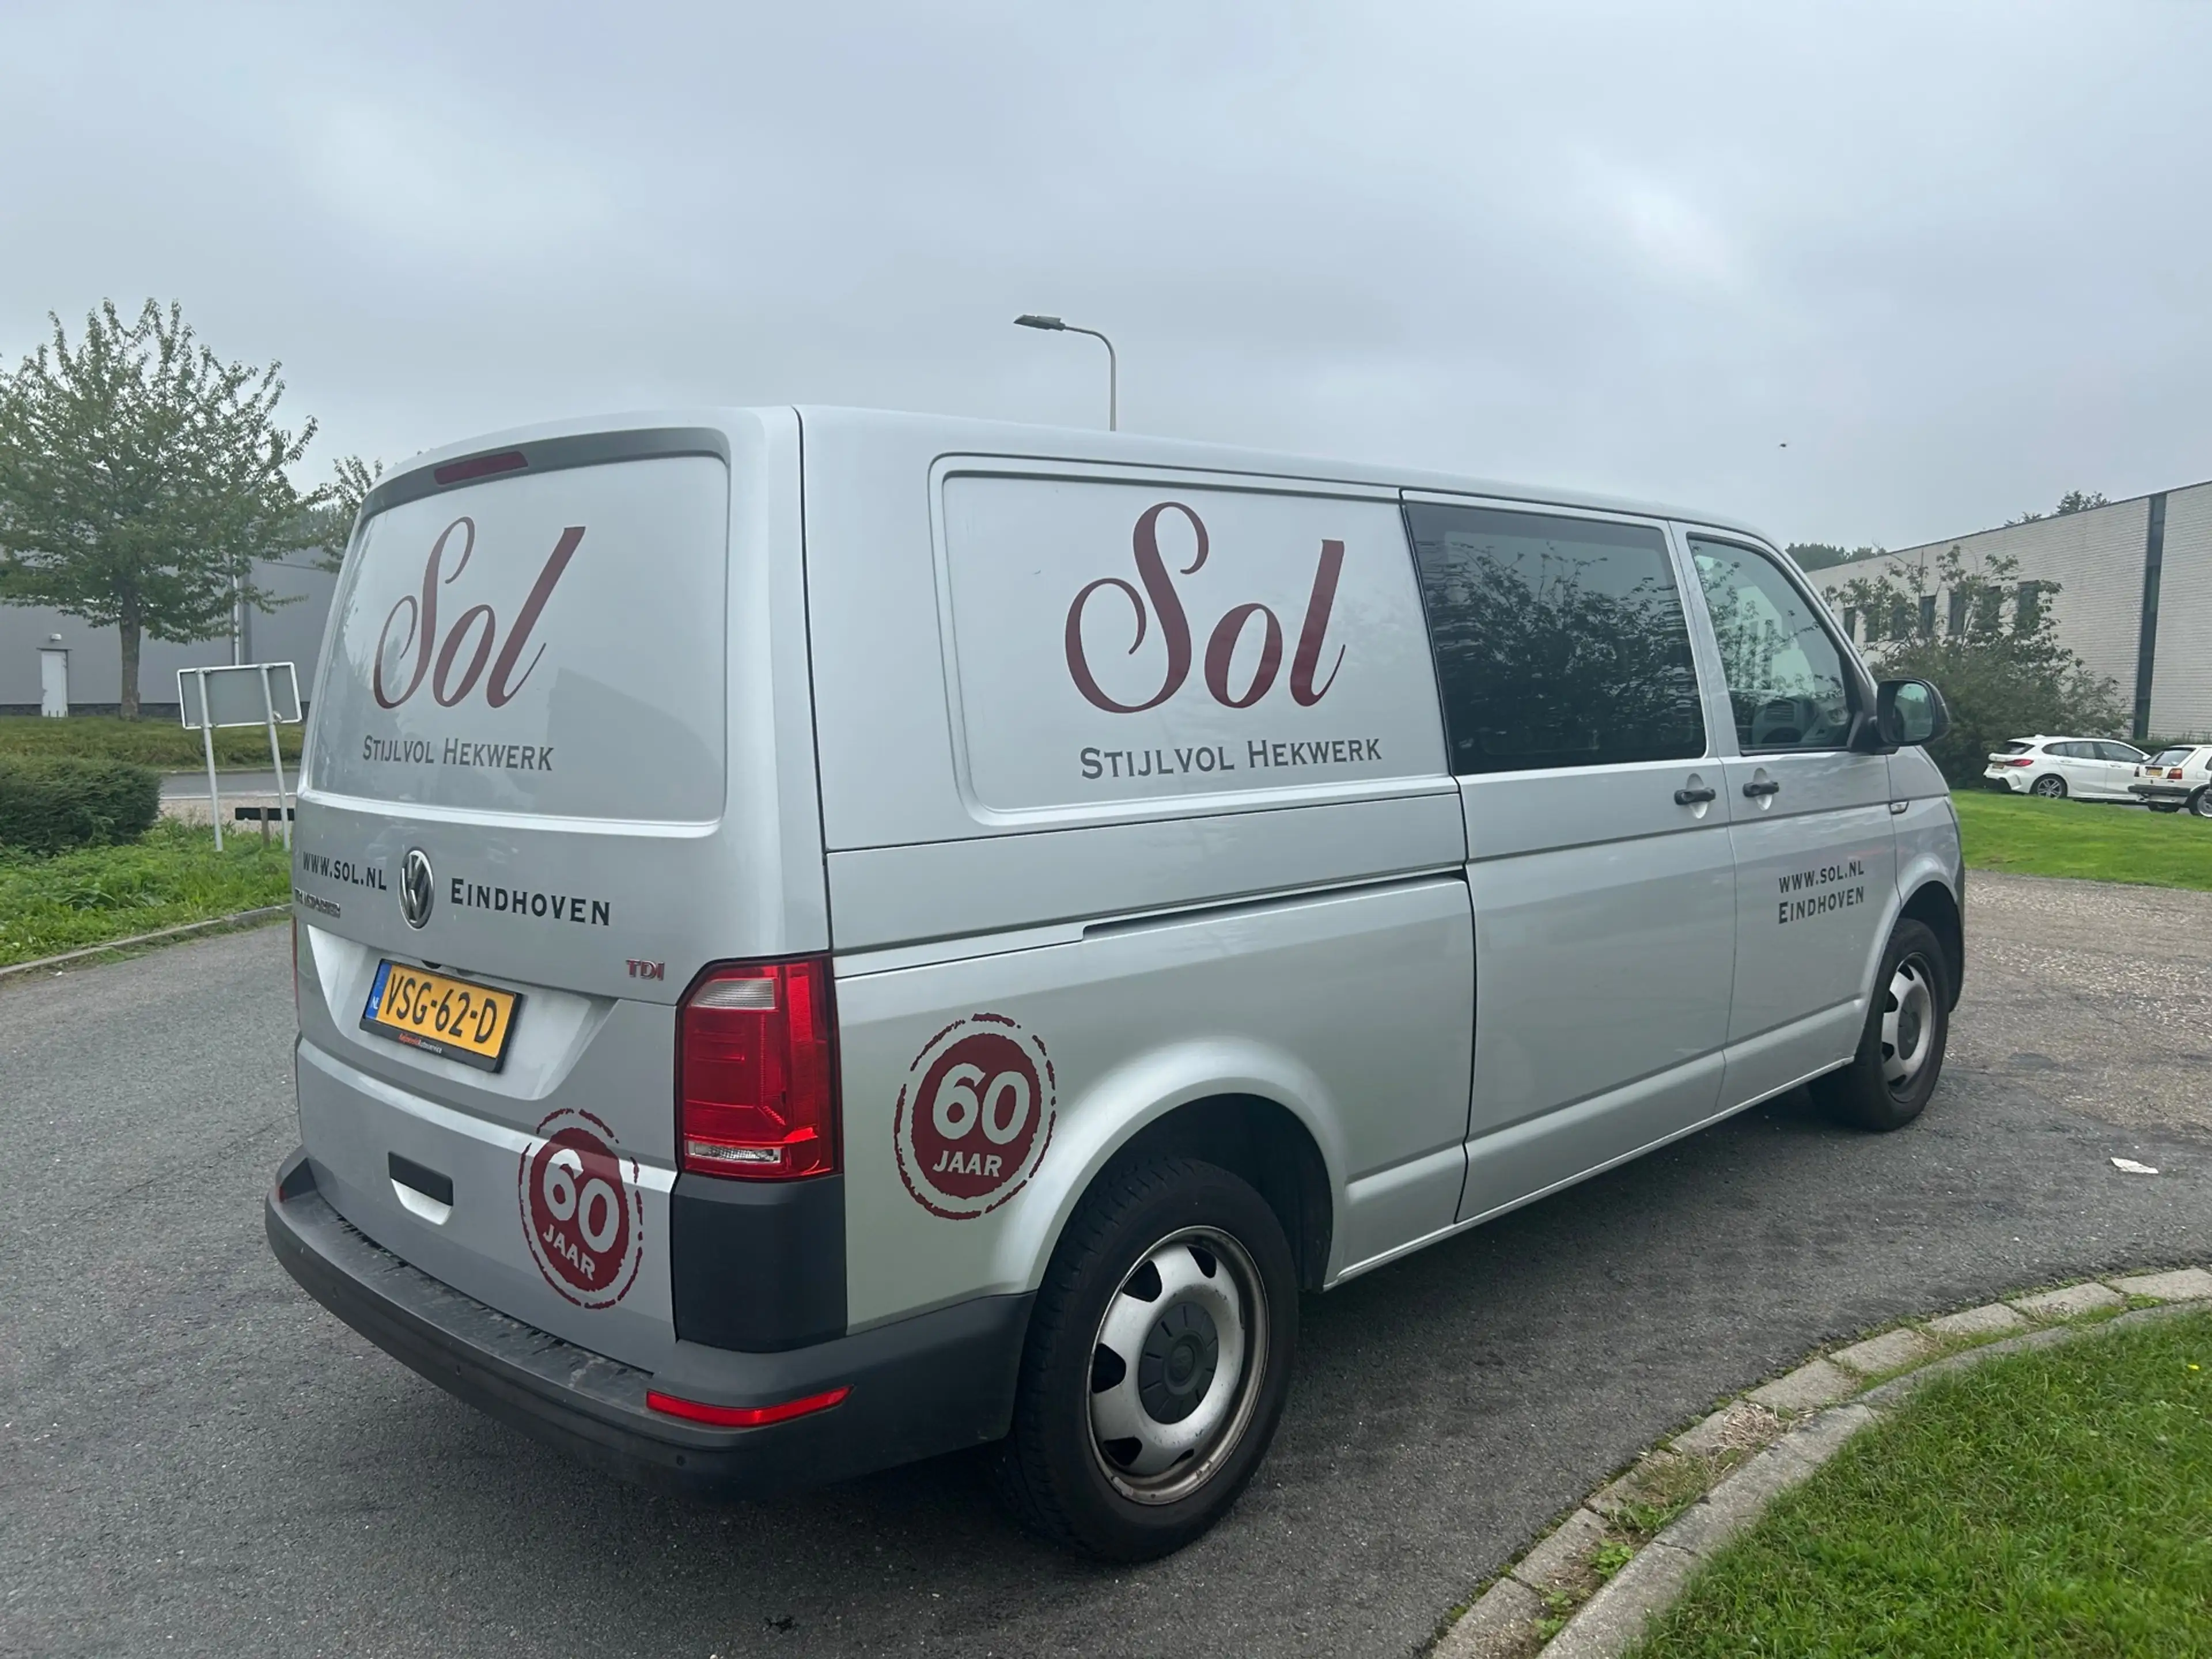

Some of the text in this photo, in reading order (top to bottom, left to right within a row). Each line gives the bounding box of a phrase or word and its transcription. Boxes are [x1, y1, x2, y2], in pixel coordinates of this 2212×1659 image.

[373, 516, 586, 709] Sol
[1065, 501, 1346, 714] Sol
[362, 734, 554, 771] STIJLVOL HEKWERK
[1080, 738, 1382, 779] STIJLVOL HEKWERK
[450, 877, 611, 926] EINDHOVEN
[1778, 885, 1864, 925] EINDHOVEN
[626, 959, 665, 981] TDI
[386, 974, 497, 1044] VSG-62-D
[933, 1062, 1031, 1145] 60
[932, 1150, 1002, 1177] JAAR
[543, 1148, 619, 1253] 60
[543, 1224, 596, 1281] JAAR
